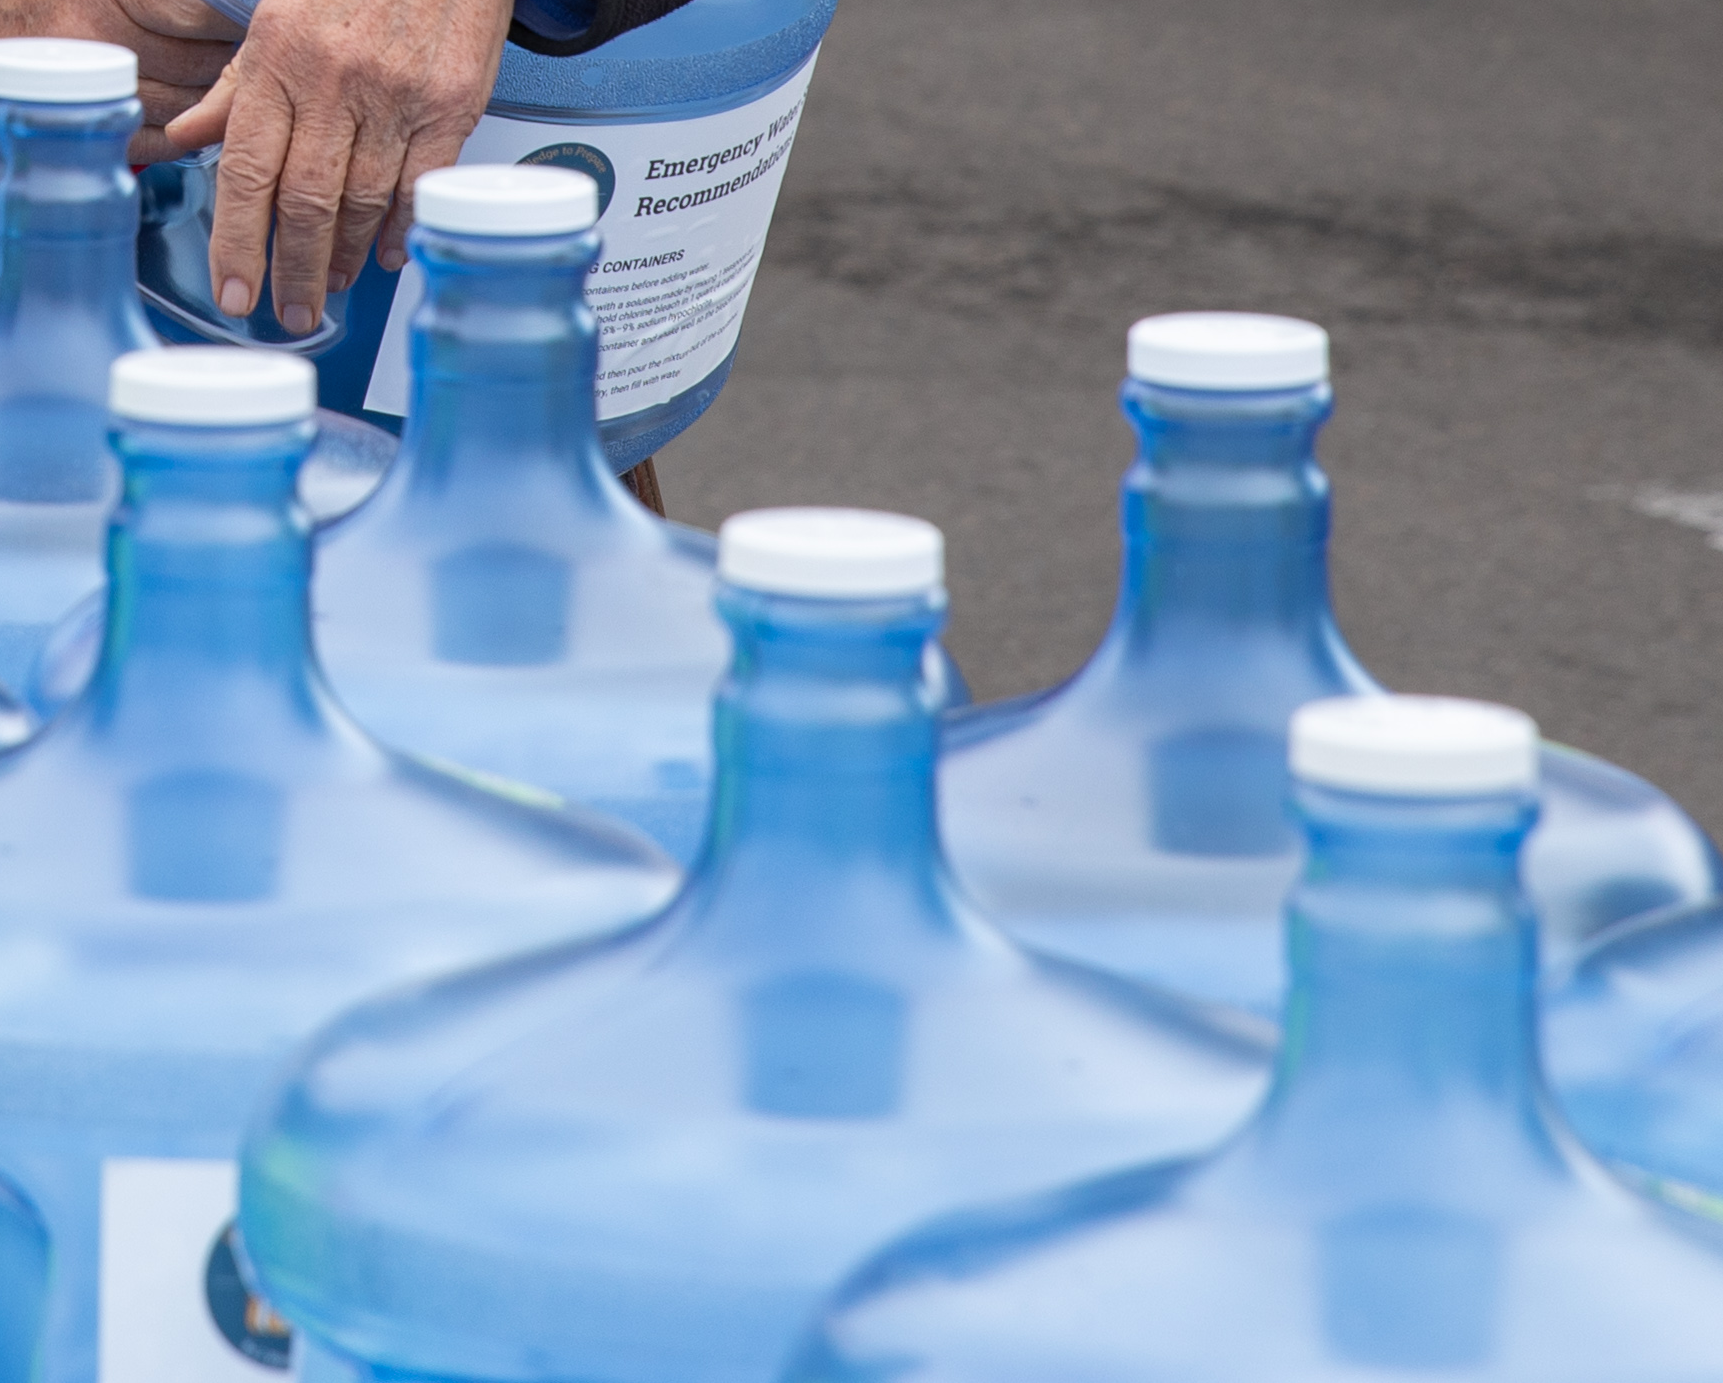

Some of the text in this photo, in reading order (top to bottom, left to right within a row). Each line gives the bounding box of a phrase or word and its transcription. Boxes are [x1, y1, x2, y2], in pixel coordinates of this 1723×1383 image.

[644, 99, 802, 181] Emergency Water
[562, 146, 574, 156] to
[575, 145, 607, 173] Prepare
[602, 248, 685, 274] CONTAINERS
[631, 278, 659, 292] before
[660, 271, 688, 286] adding
[596, 301, 616, 312] with
[617, 302, 624, 310] a
[625, 295, 660, 310] solution
[661, 288, 684, 301] made
[684, 284, 694, 295] by
[618, 309, 653, 322] chlorine
[654, 301, 680, 314] bleach
[681, 297, 689, 306] in
[695, 285, 715, 301] quart
[637, 316, 667, 330] sodium
[641, 334, 658, 346] and
[607, 369, 627, 380] then
[628, 363, 647, 377] pour
[648, 360, 662, 371] the
[610, 384, 629, 395] then
[631, 379, 642, 391] fill
[643, 375, 659, 387] with
